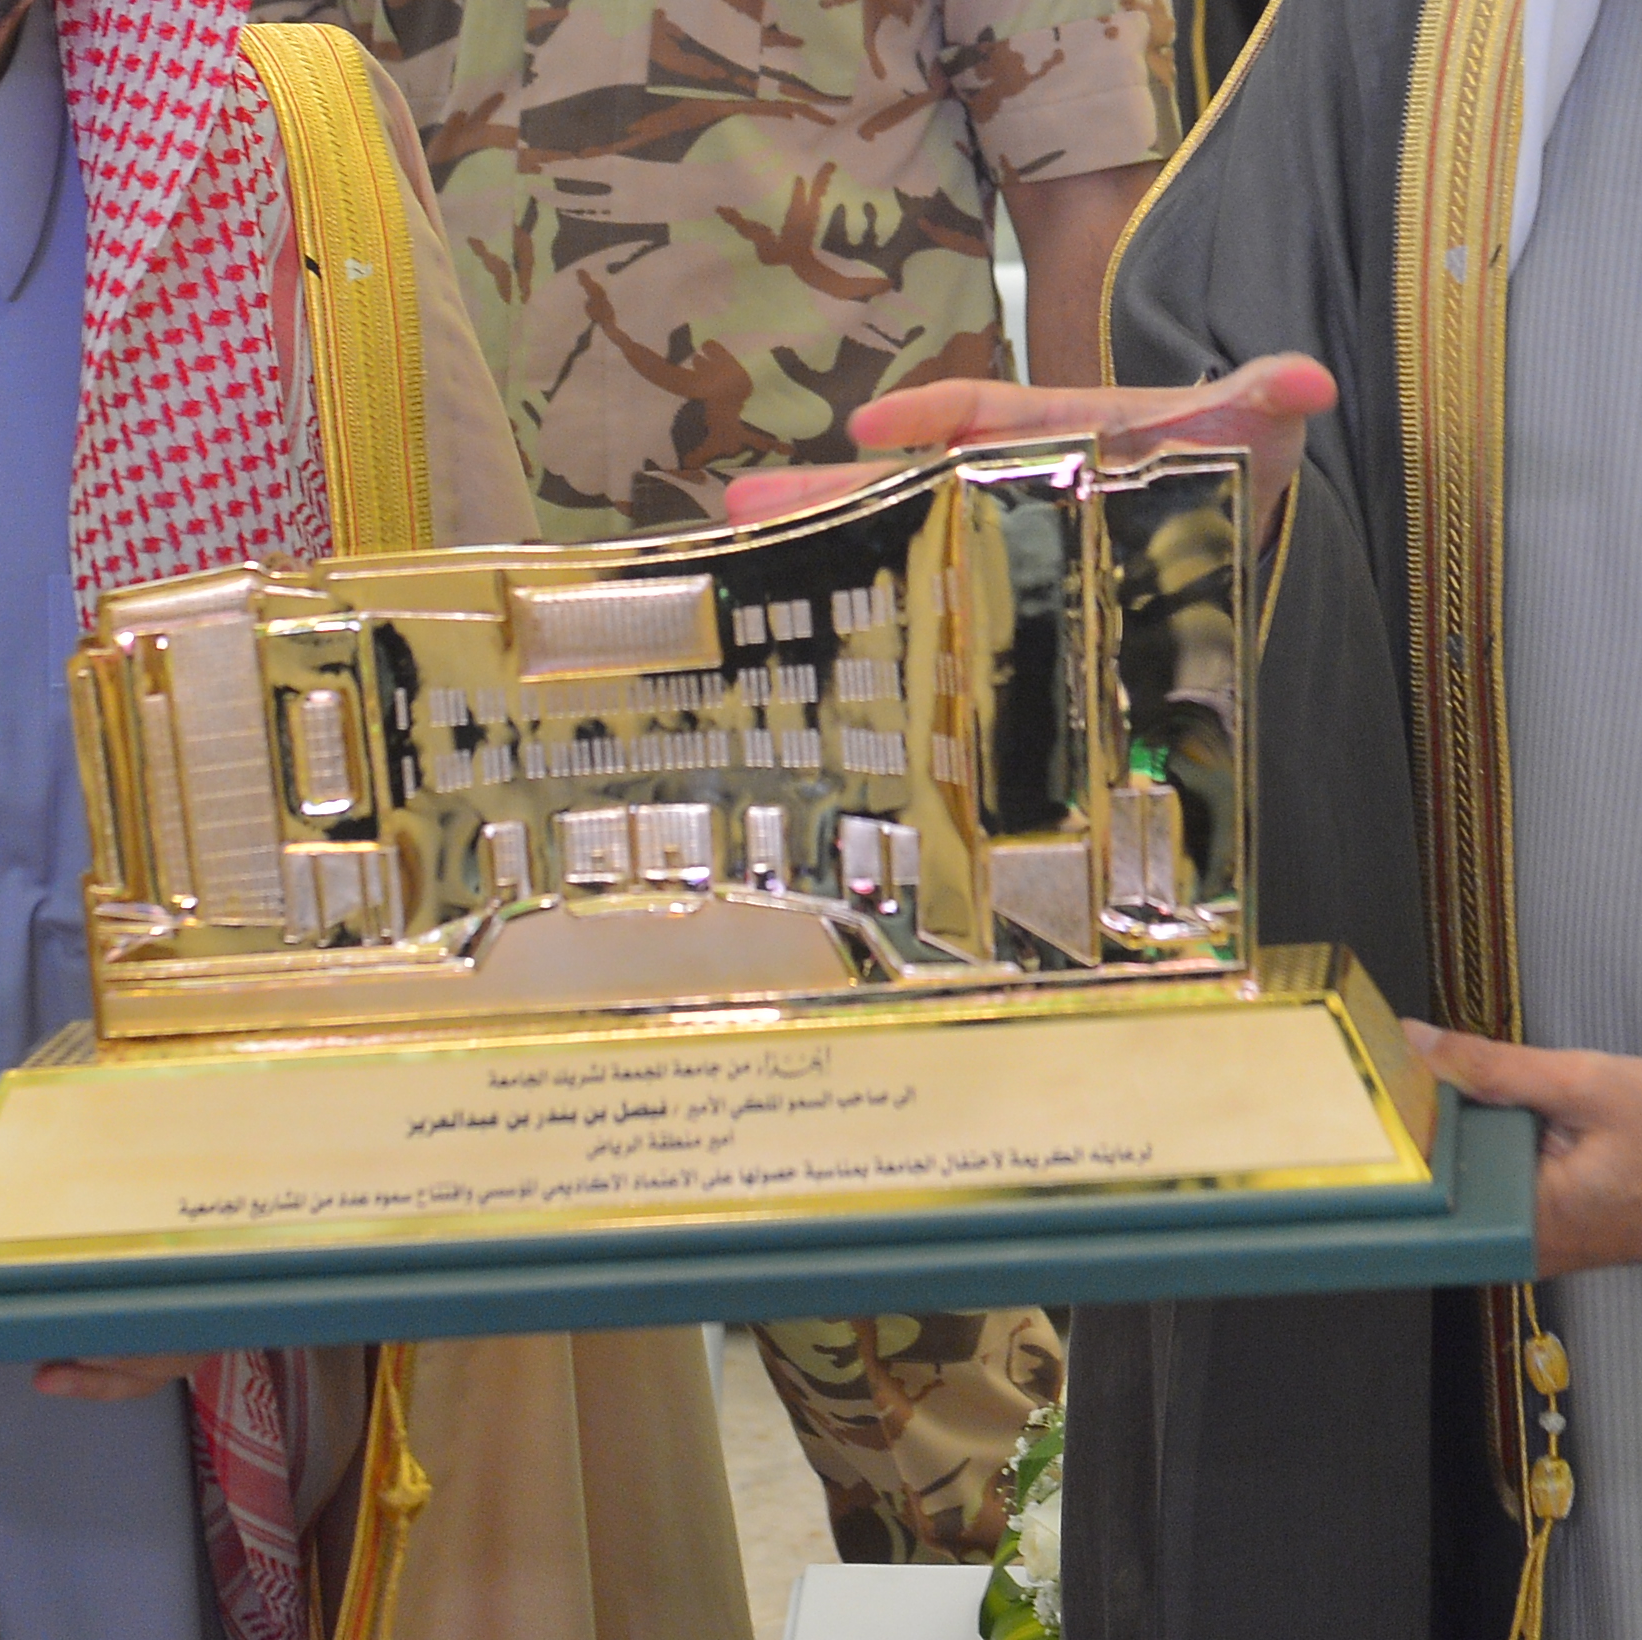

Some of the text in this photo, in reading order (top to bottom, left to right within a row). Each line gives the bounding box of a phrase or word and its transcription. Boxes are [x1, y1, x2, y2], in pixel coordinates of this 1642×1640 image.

[583, 1107, 607, 1127] بن
[613, 1098, 667, 1125] فيصل
[507, 1112, 529, 1132] بن
